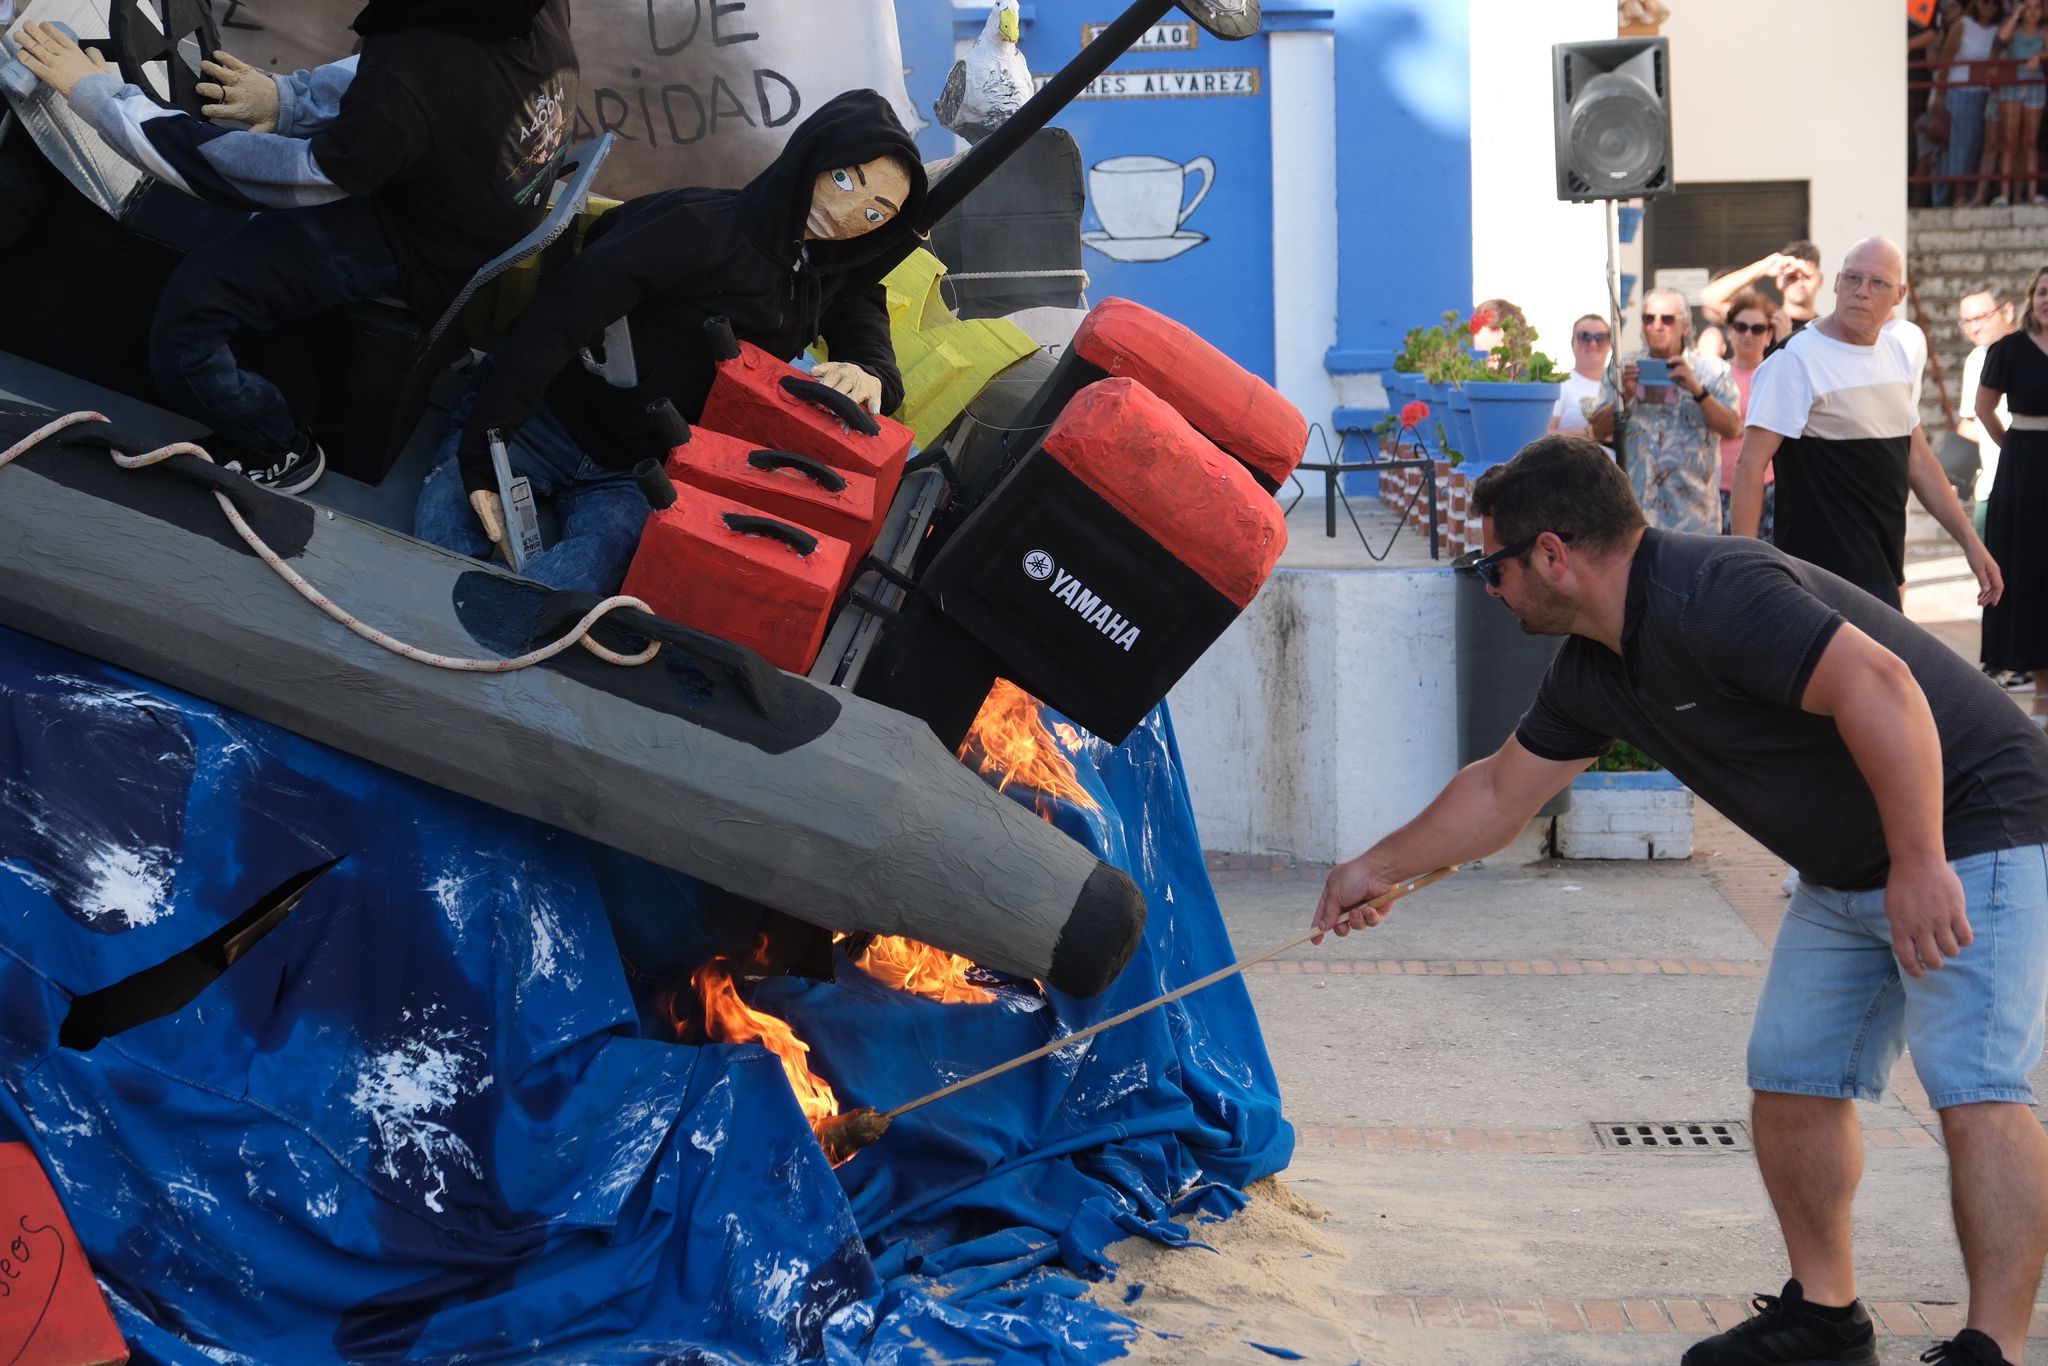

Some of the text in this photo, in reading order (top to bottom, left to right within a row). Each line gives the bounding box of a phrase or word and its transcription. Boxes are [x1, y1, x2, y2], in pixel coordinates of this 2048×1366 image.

[646, 0, 760, 56] DE
[1145, 74, 1245, 93] ALVAREZ
[520, 87, 564, 142] A400M
[1049, 568, 1141, 652] YAMAHA
